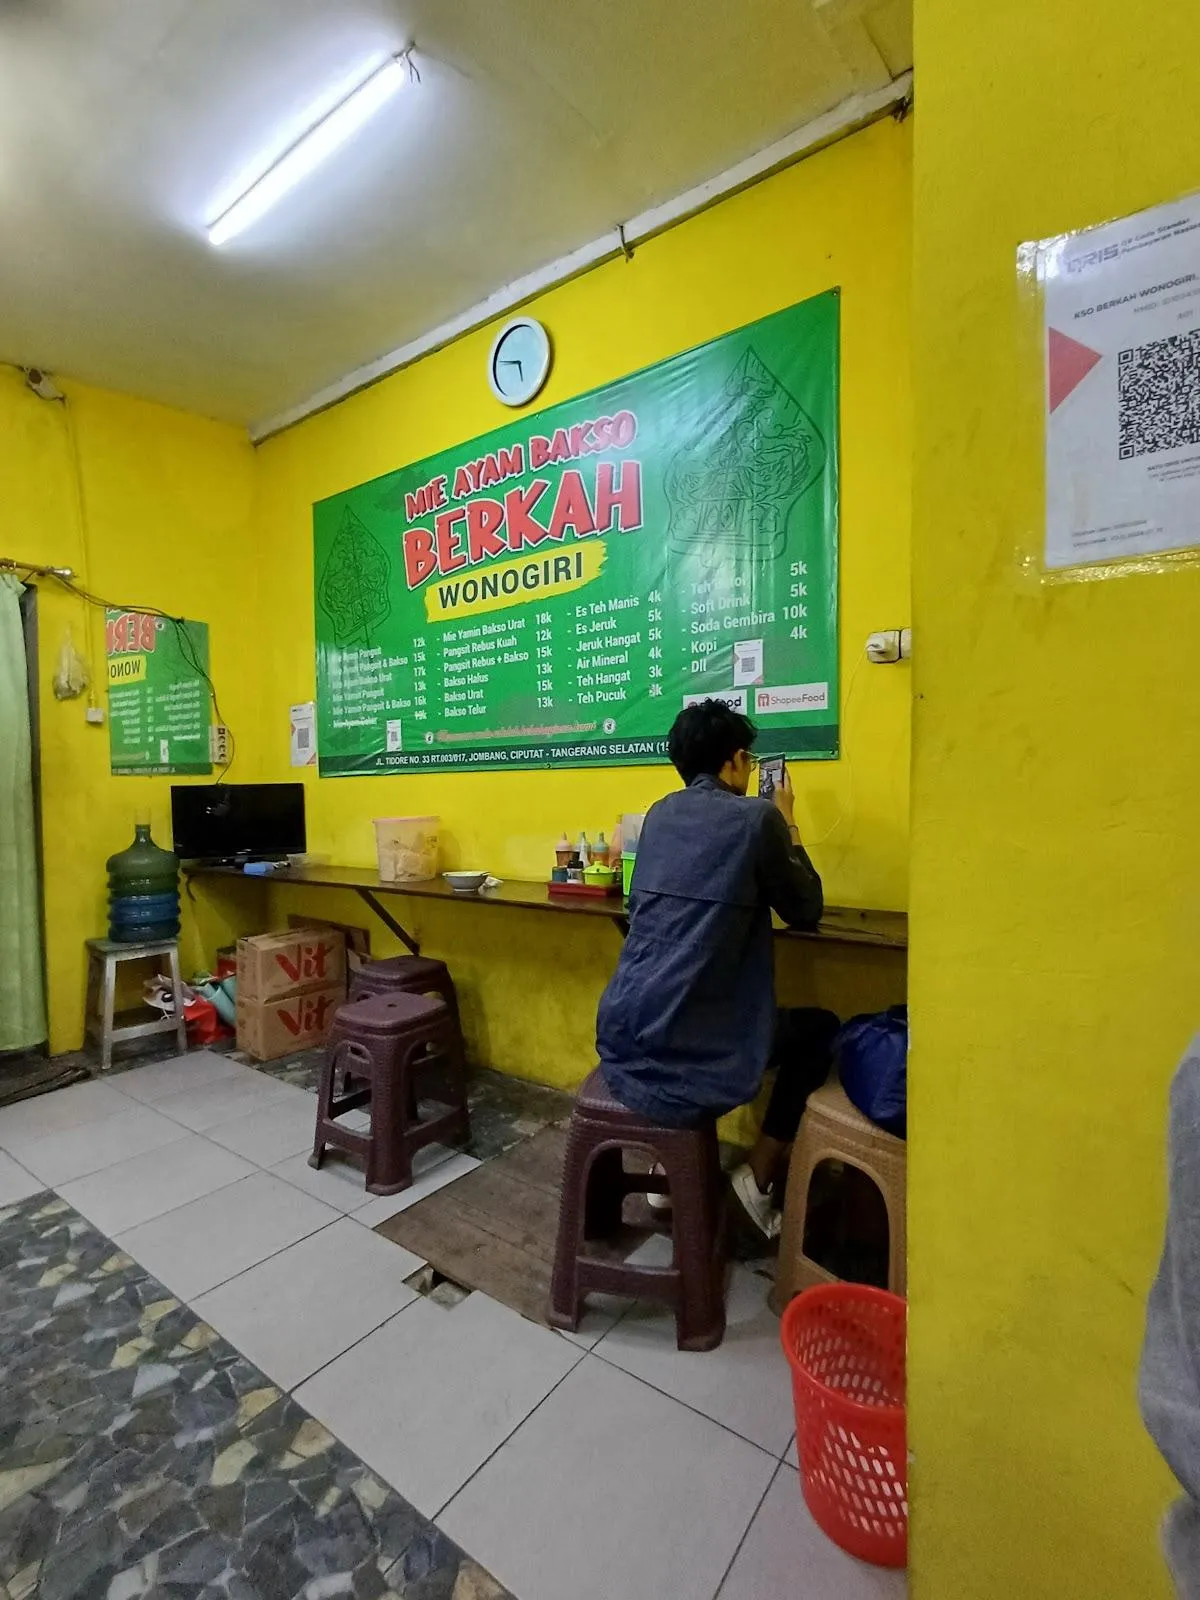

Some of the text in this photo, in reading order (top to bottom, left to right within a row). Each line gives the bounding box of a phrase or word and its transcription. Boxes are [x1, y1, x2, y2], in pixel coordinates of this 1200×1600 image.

[1074, 307, 1094, 319] KSO
[1096, 292, 1137, 312] BERKAH
[404, 410, 638, 522] MIE AYAM BAKSO
[402, 460, 643, 590] BERKAH
[438, 552, 583, 609] WONOGIRI
[790, 561, 808, 576] 5k
[576, 590, 661, 617] Es Teh Manis 4k
[690, 600, 714, 614] Soft
[790, 582, 808, 597] 5k
[458, 626, 480, 640] Yamin
[482, 623, 506, 636] Bakso
[508, 618, 526, 630] Urat
[536, 612, 552, 624] 18k
[576, 608, 662, 634] Es Jeruk 5k
[690, 604, 808, 634] Soda Gembira 10k
[413, 637, 426, 648] 12k
[444, 630, 552, 658] Pangsit Rebus Kuah 12k
[576, 628, 662, 652] Jeruk Hangat 5k
[691, 638, 717, 654] Kopi
[790, 624, 808, 640] 4k
[414, 652, 426, 662] 15k
[444, 659, 470, 672] Pangsit
[472, 656, 496, 668] Rebus
[504, 651, 529, 664] Bakso
[536, 646, 552, 658] 15k
[576, 646, 662, 670] Air Mineral 4k
[414, 666, 426, 677] 17k
[444, 677, 466, 688] Bakso
[536, 662, 552, 675] 13k
[576, 665, 662, 687] Teh Hangat 3k
[414, 680, 426, 692] 13k
[444, 680, 553, 702] Bakso Urat 15k
[577, 692, 594, 704] Teh
[596, 687, 627, 702] Pucuk
[771, 692, 825, 706] ShopeeFood
[444, 696, 554, 718] Bakso Telur 13k
[386, 756, 408, 766] TIDORE
[422, 755, 430, 764] 33
[468, 751, 509, 762] JOMBANG,
[511, 749, 544, 760] CIPUTAT
[550, 746, 608, 758] TANGERANG
[609, 742, 654, 754] SELATAN
[275, 942, 335, 982] Vit
[277, 996, 335, 1036] Vit
